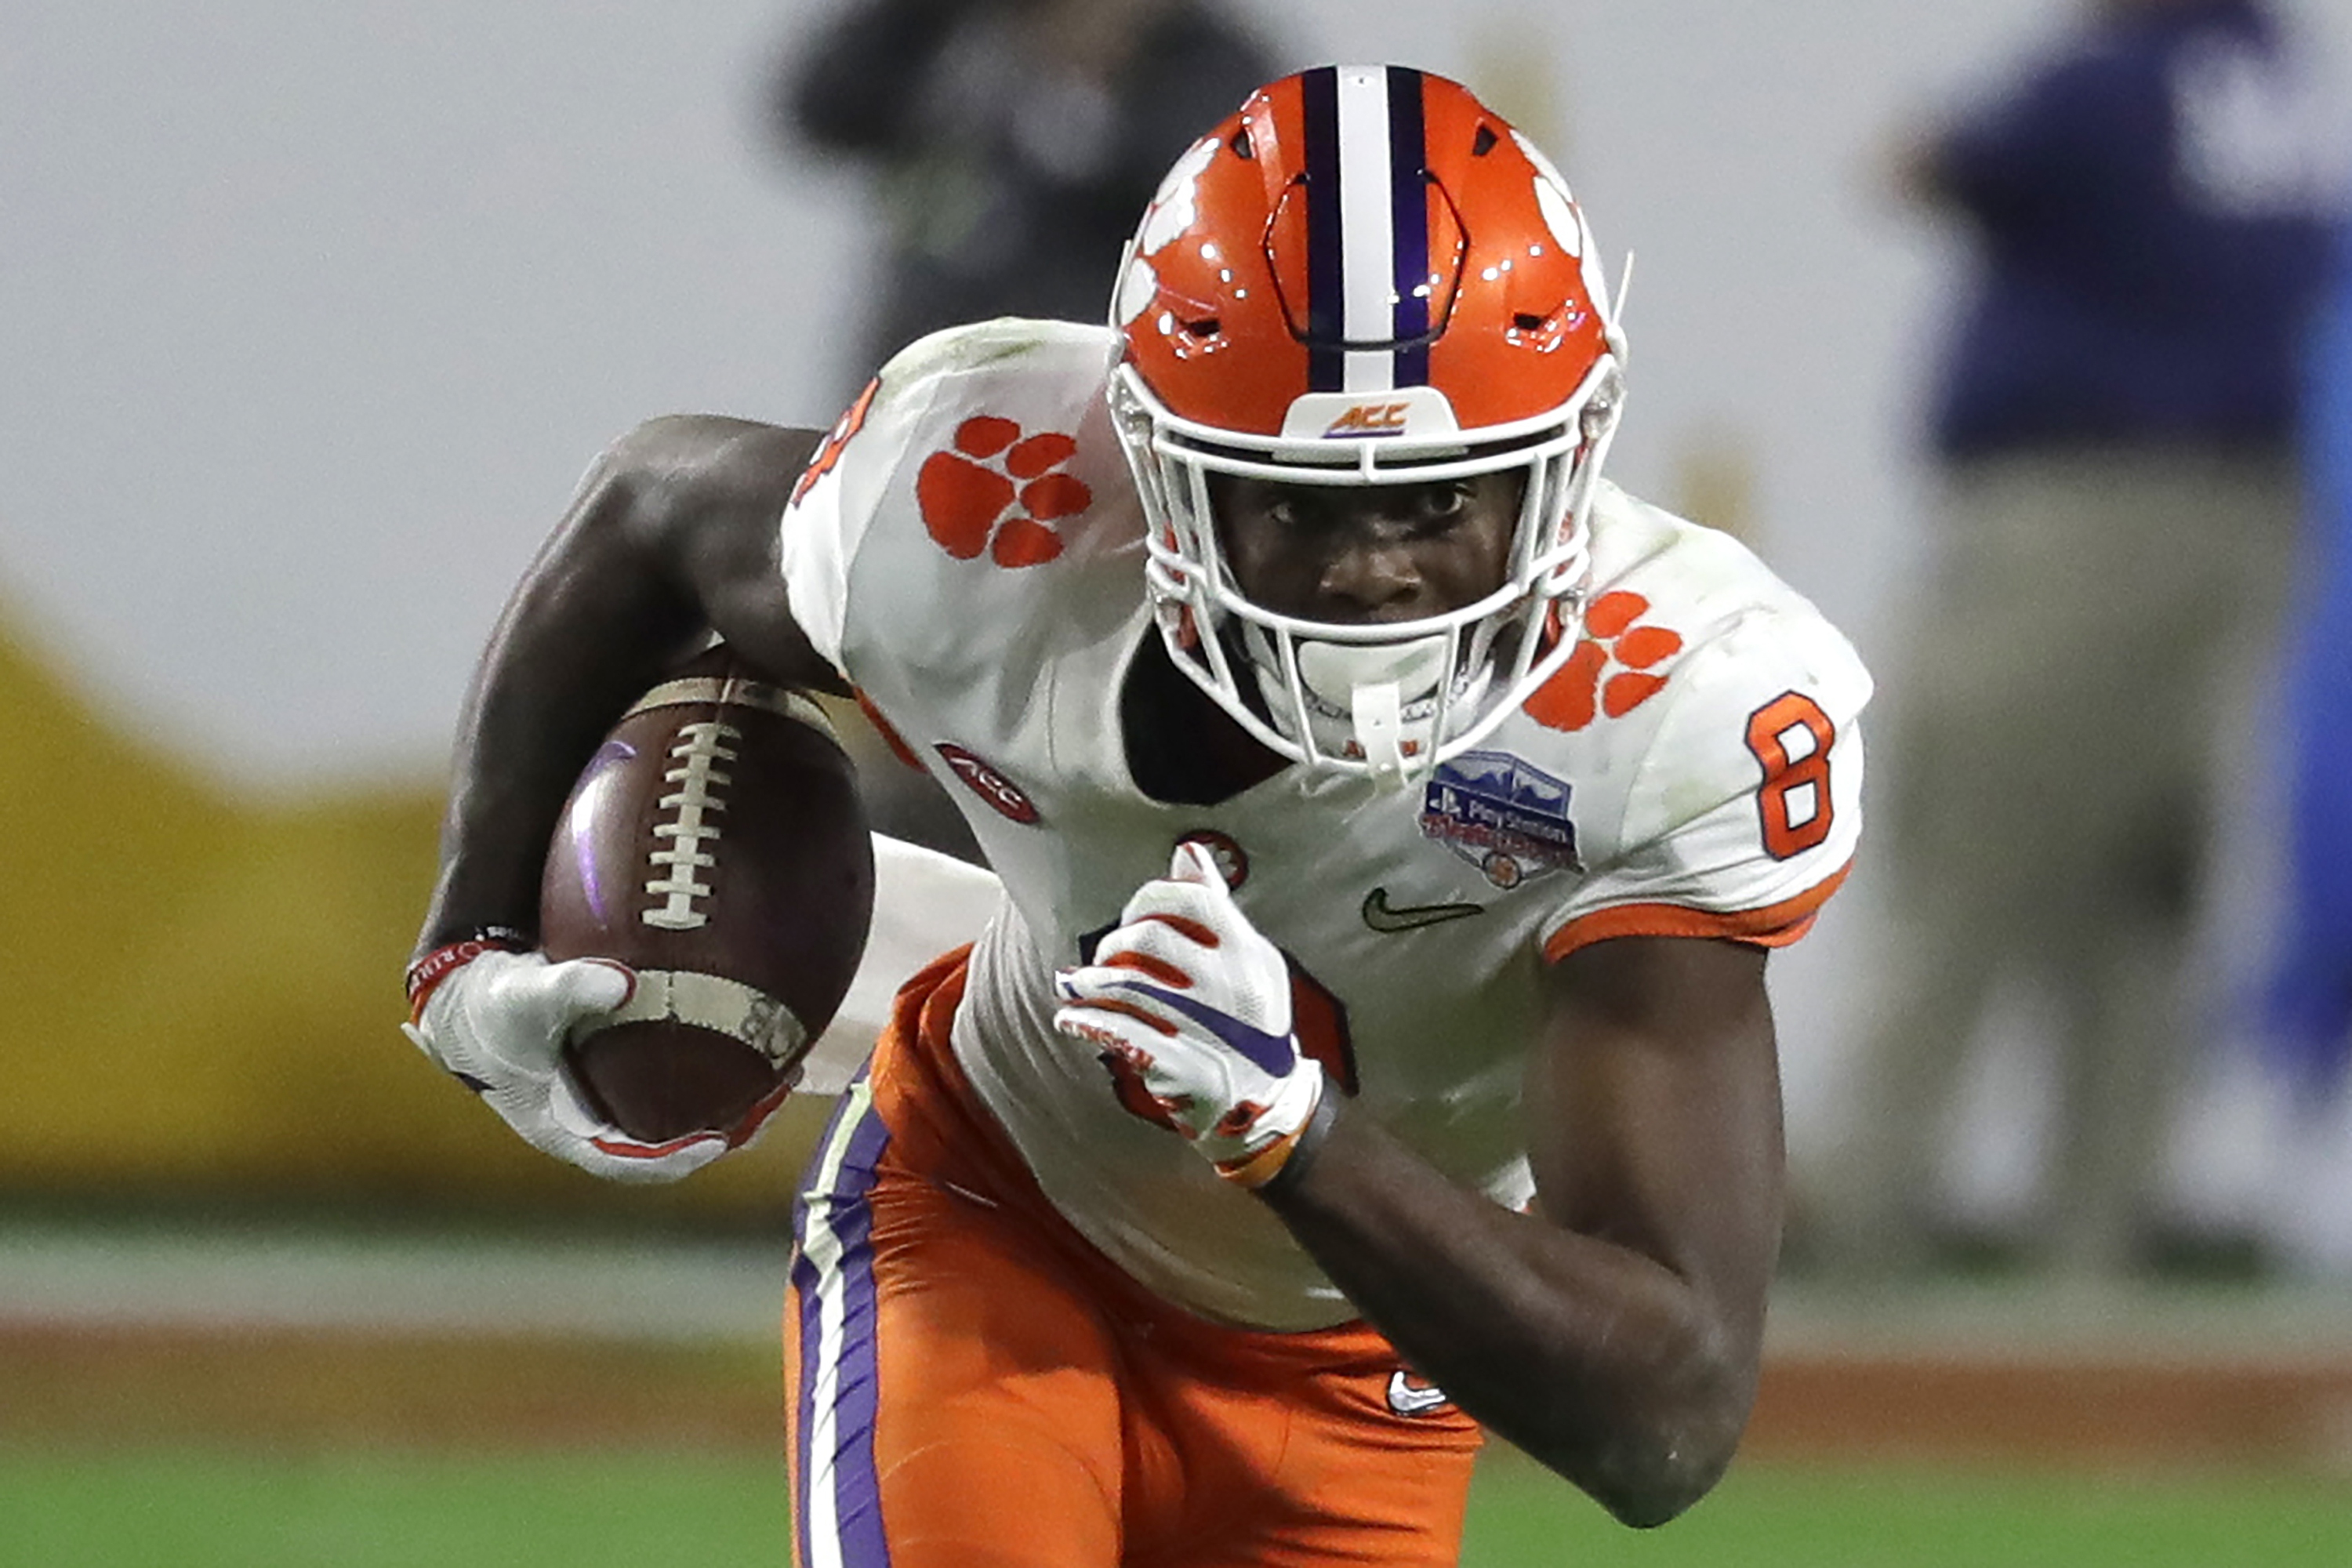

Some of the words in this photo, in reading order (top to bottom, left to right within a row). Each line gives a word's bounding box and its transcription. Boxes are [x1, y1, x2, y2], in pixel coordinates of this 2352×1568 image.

[1329, 401, 1411, 429] ACC
[949, 757, 1023, 810] ACC
[1744, 689, 1836, 862] 8
